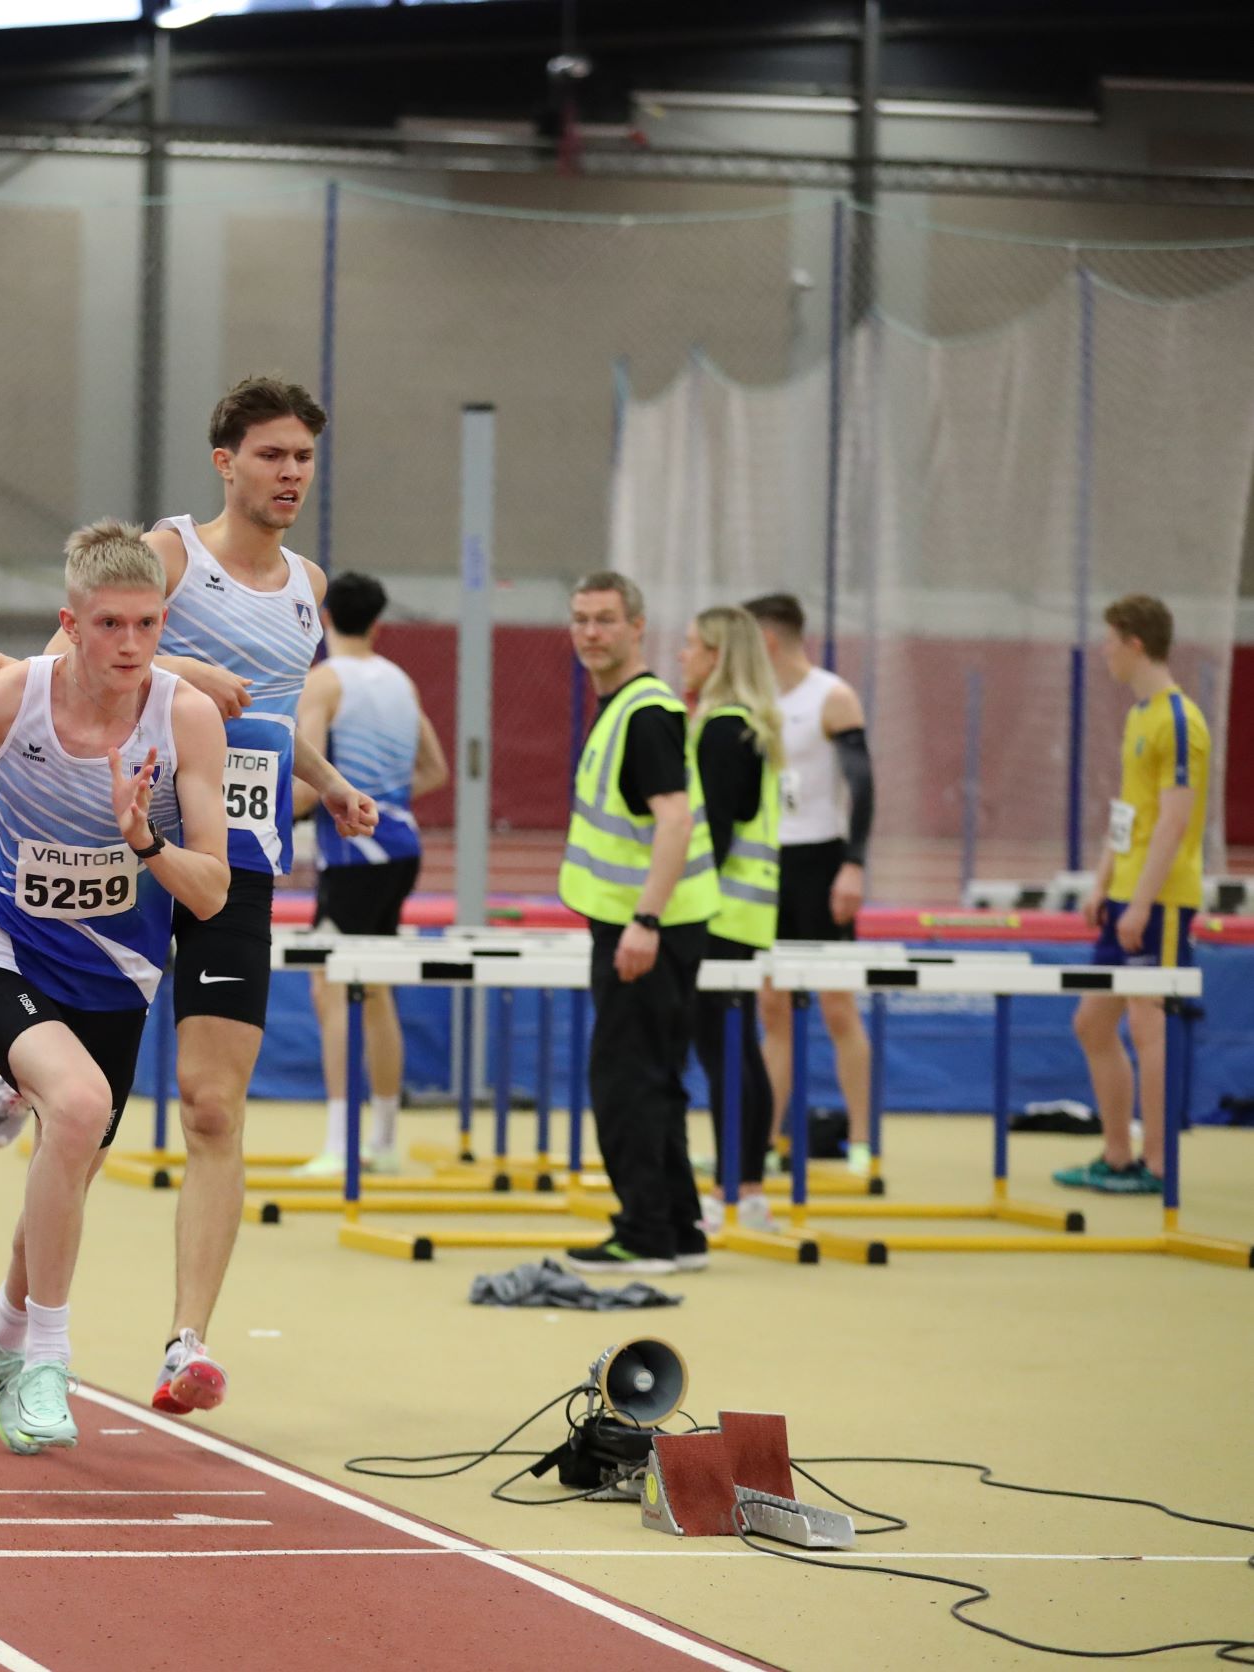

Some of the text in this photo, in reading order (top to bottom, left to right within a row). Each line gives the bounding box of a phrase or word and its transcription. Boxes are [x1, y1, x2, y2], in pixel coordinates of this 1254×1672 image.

[224, 753, 269, 772] ITOR
[222, 783, 268, 820] 58
[31, 846, 125, 867] VALITOR
[24, 873, 129, 910] 5259
[17, 993, 38, 1015] FUSION
